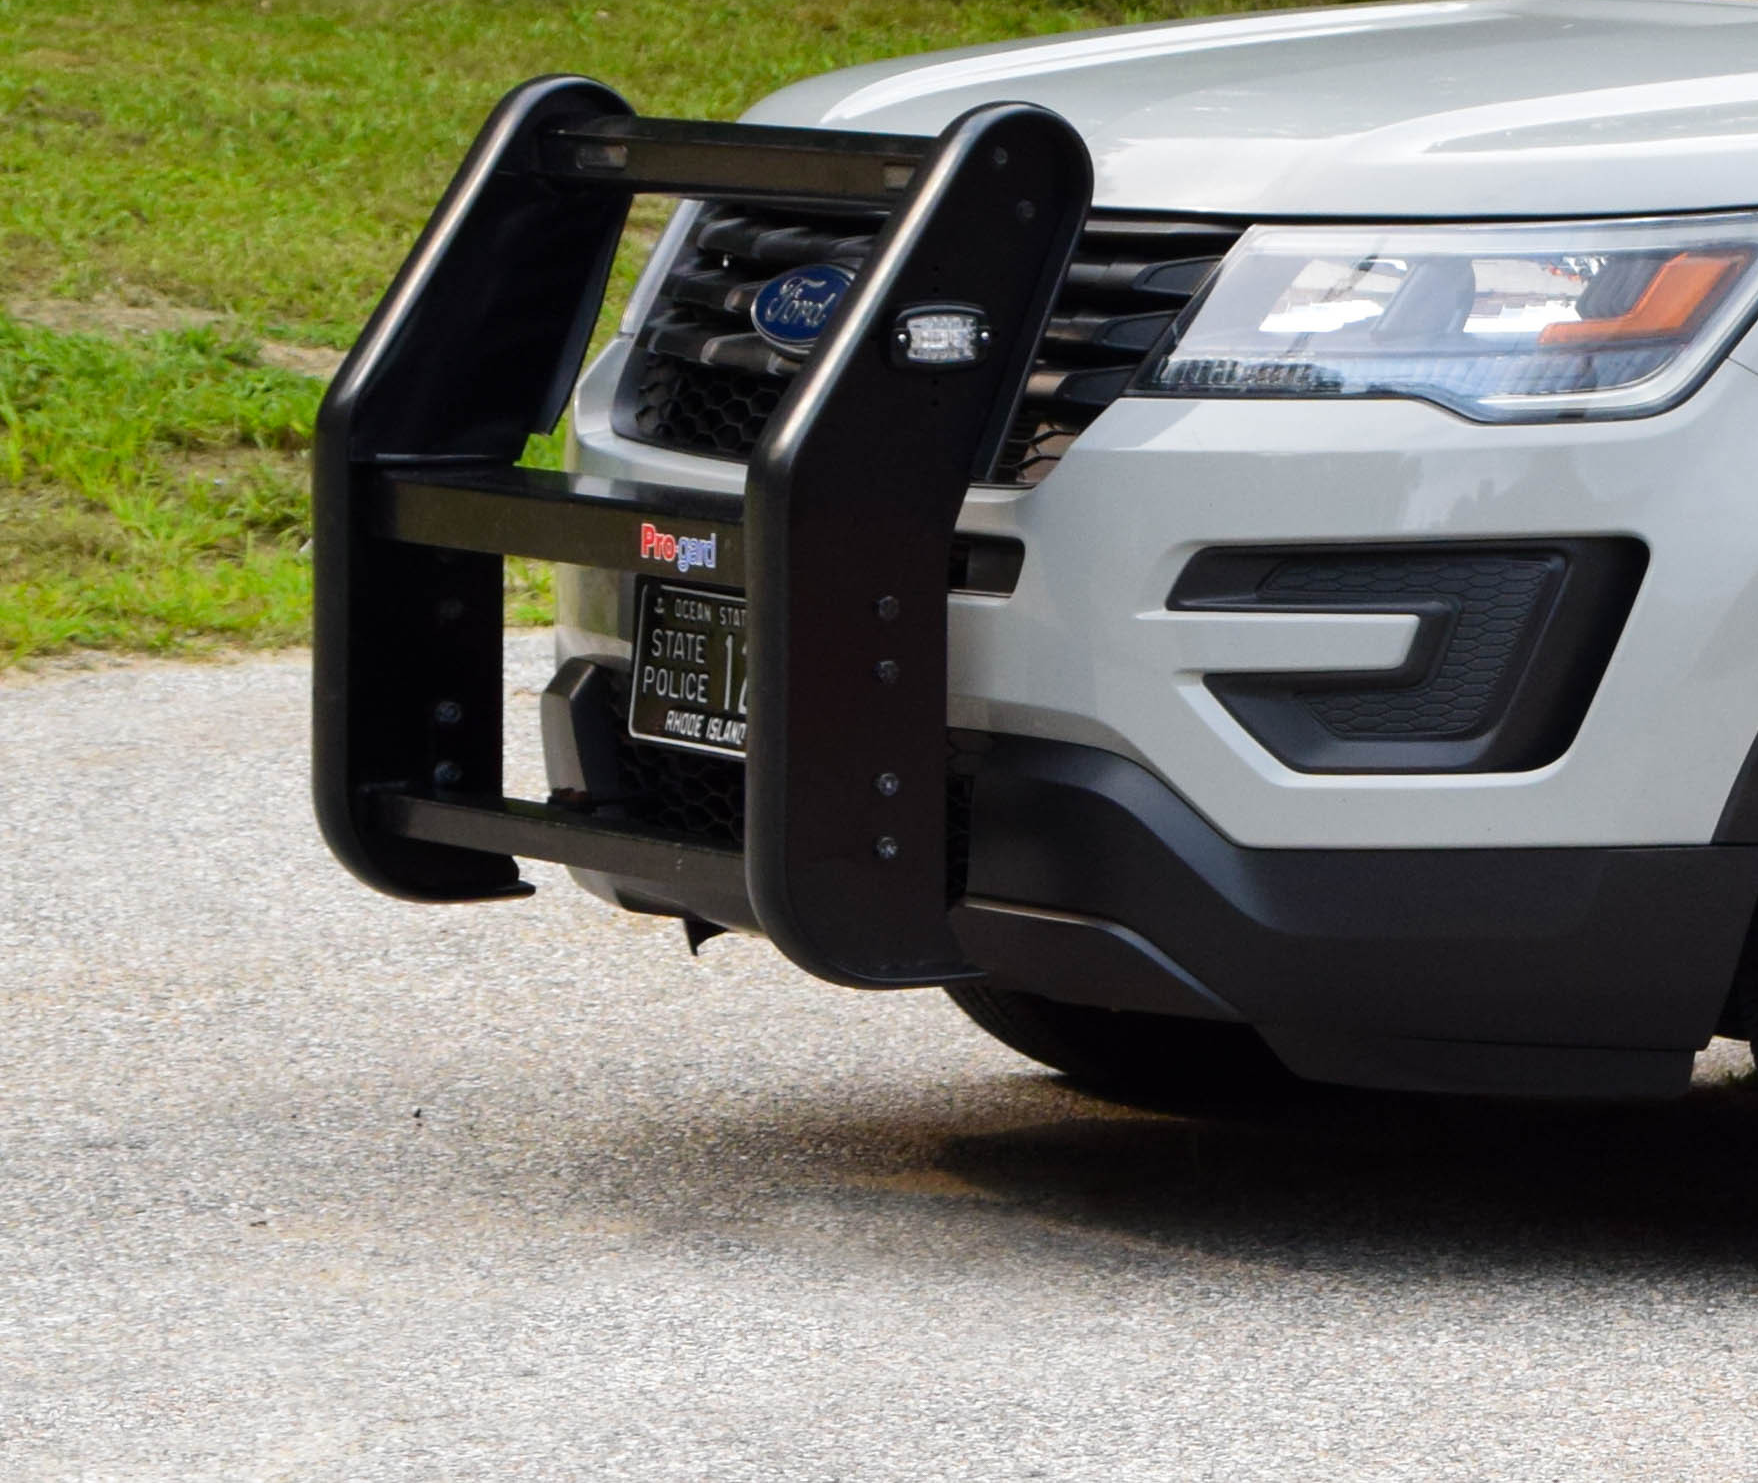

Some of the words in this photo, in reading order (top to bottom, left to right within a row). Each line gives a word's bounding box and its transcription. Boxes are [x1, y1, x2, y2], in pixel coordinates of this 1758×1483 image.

[766, 277, 837, 327] Ford
[675, 600, 711, 622] OCEAN
[720, 607, 747, 627] STAT
[652, 629, 707, 663] STATE
[644, 666, 709, 703] POLICE
[666, 711, 704, 737] RHODE
